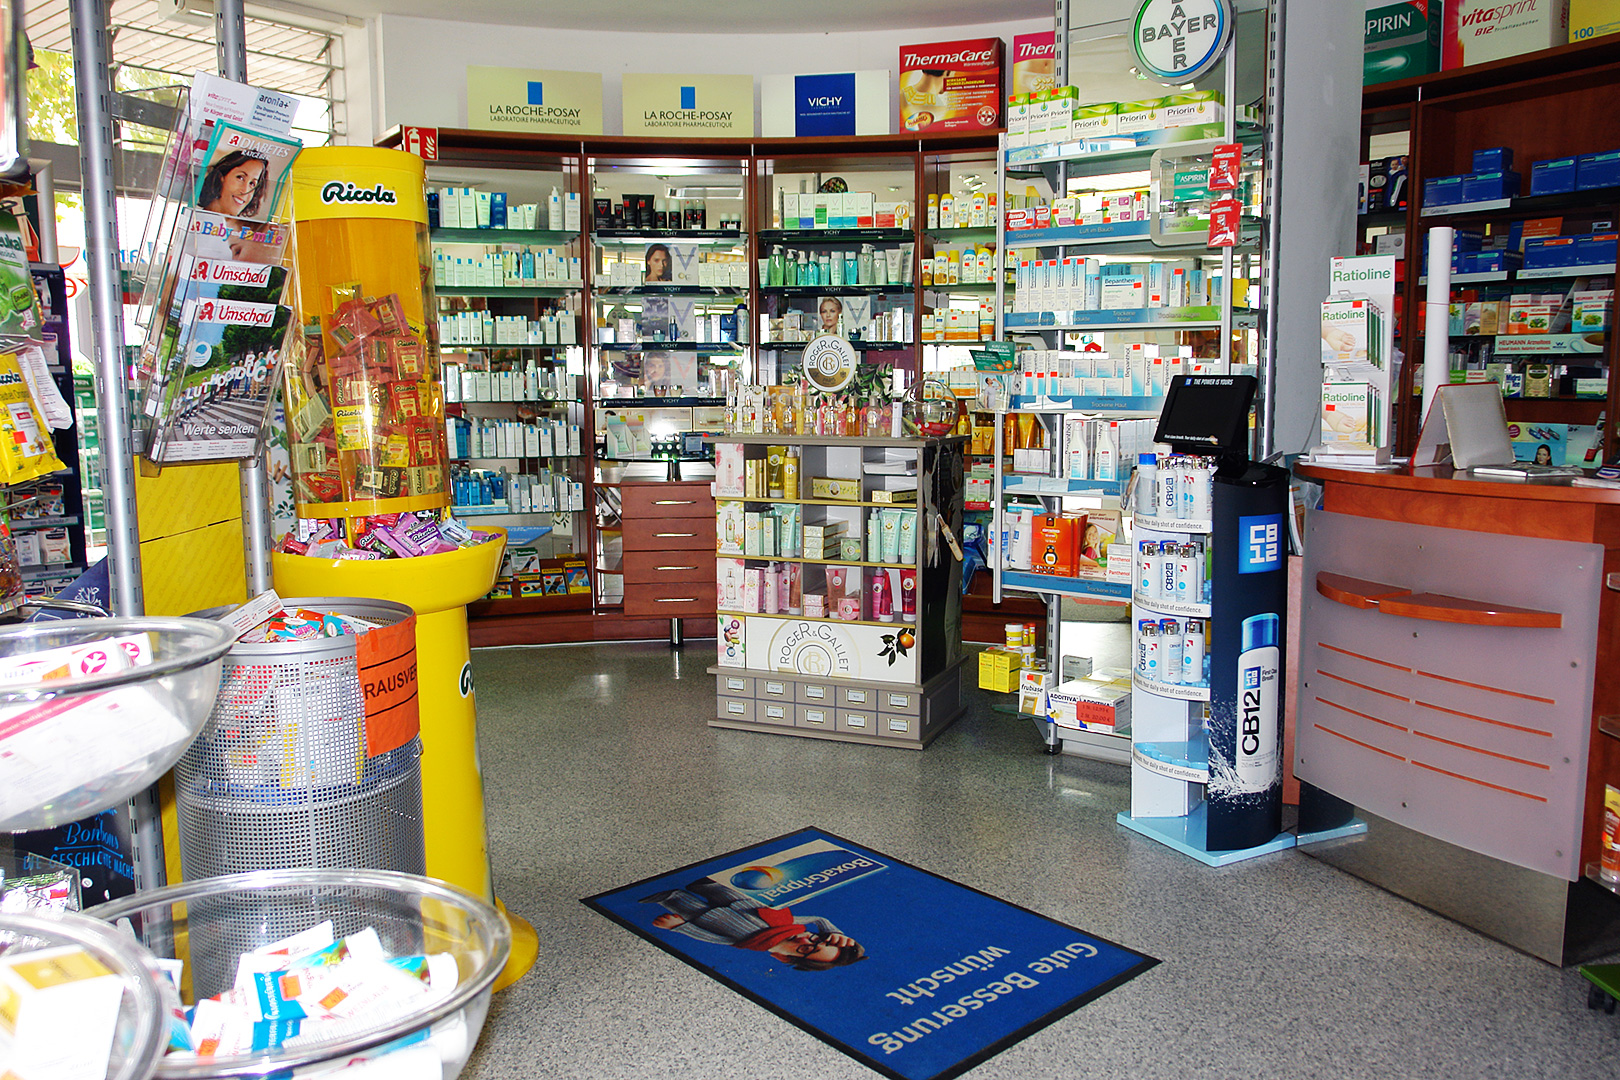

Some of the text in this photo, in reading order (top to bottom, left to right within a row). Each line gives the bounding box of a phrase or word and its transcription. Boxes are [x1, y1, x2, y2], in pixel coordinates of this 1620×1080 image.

[1415, 1, 1426, 12] NEU
[1143, 13, 1217, 43] BAYER
[1475, 26, 1494, 36] B12
[1573, 26, 1594, 40] 100
[904, 50, 992, 67] ThermaCare
[259, 94, 289, 109] aronia+
[808, 96, 842, 107] VICHY
[489, 105, 581, 118] LA ROCHE-POSAY
[644, 111, 733, 121] LA ROCHE-POSAY
[1120, 114, 1147, 122] Priorin
[1167, 106, 1195, 116] Priorin
[489, 115, 581, 126] LABORATOIRE PHARMACEUTIQUE
[1075, 120, 1099, 128] Priorin
[240, 138, 290, 158] DIABETES
[1179, 174, 1206, 182] ASPIRIN
[322, 182, 396, 203] Ricola
[201, 222, 283, 245] Baby Familie
[213, 264, 267, 285] Umschau
[1105, 277, 1136, 285] Bepanthen
[1333, 268, 1391, 282] Ratioline
[219, 305, 272, 324] Umschau
[1323, 309, 1365, 321] Ratioline
[809, 340, 827, 368] ROGER
[830, 340, 850, 367] GALLET
[394, 385, 416, 393] Ricola
[1323, 392, 1365, 402] Ratioline
[336, 409, 363, 417] Ricola
[184, 423, 255, 437] Werte senken
[1166, 485, 1174, 507] CB12
[1151, 520, 1160, 528] daily
[412, 526, 436, 541] Ricola
[1250, 523, 1277, 544] CB
[1250, 543, 1277, 564] 12
[1166, 571, 1174, 591] CB12
[1150, 601, 1160, 609] daily
[779, 622, 810, 665] ROGER
[817, 624, 849, 672] GALLET
[1021, 683, 1043, 693] frubiase
[1150, 684, 1159, 692] daily
[1175, 689, 1204, 697] confidence.
[1050, 693, 1077, 703] ADDITIVA
[1242, 690, 1261, 756] CB12
[1150, 761, 1158, 769] daily
[1174, 769, 1202, 780] confidence.
[63, 820, 119, 849] Bonbons
[23, 855, 42, 870] DIE
[50, 851, 112, 869] GESCHICHTE
[757, 857, 876, 903] BoxaGrippal
[886, 945, 1011, 1006] wünscht
[867, 942, 1098, 1054] Gute Besserung
